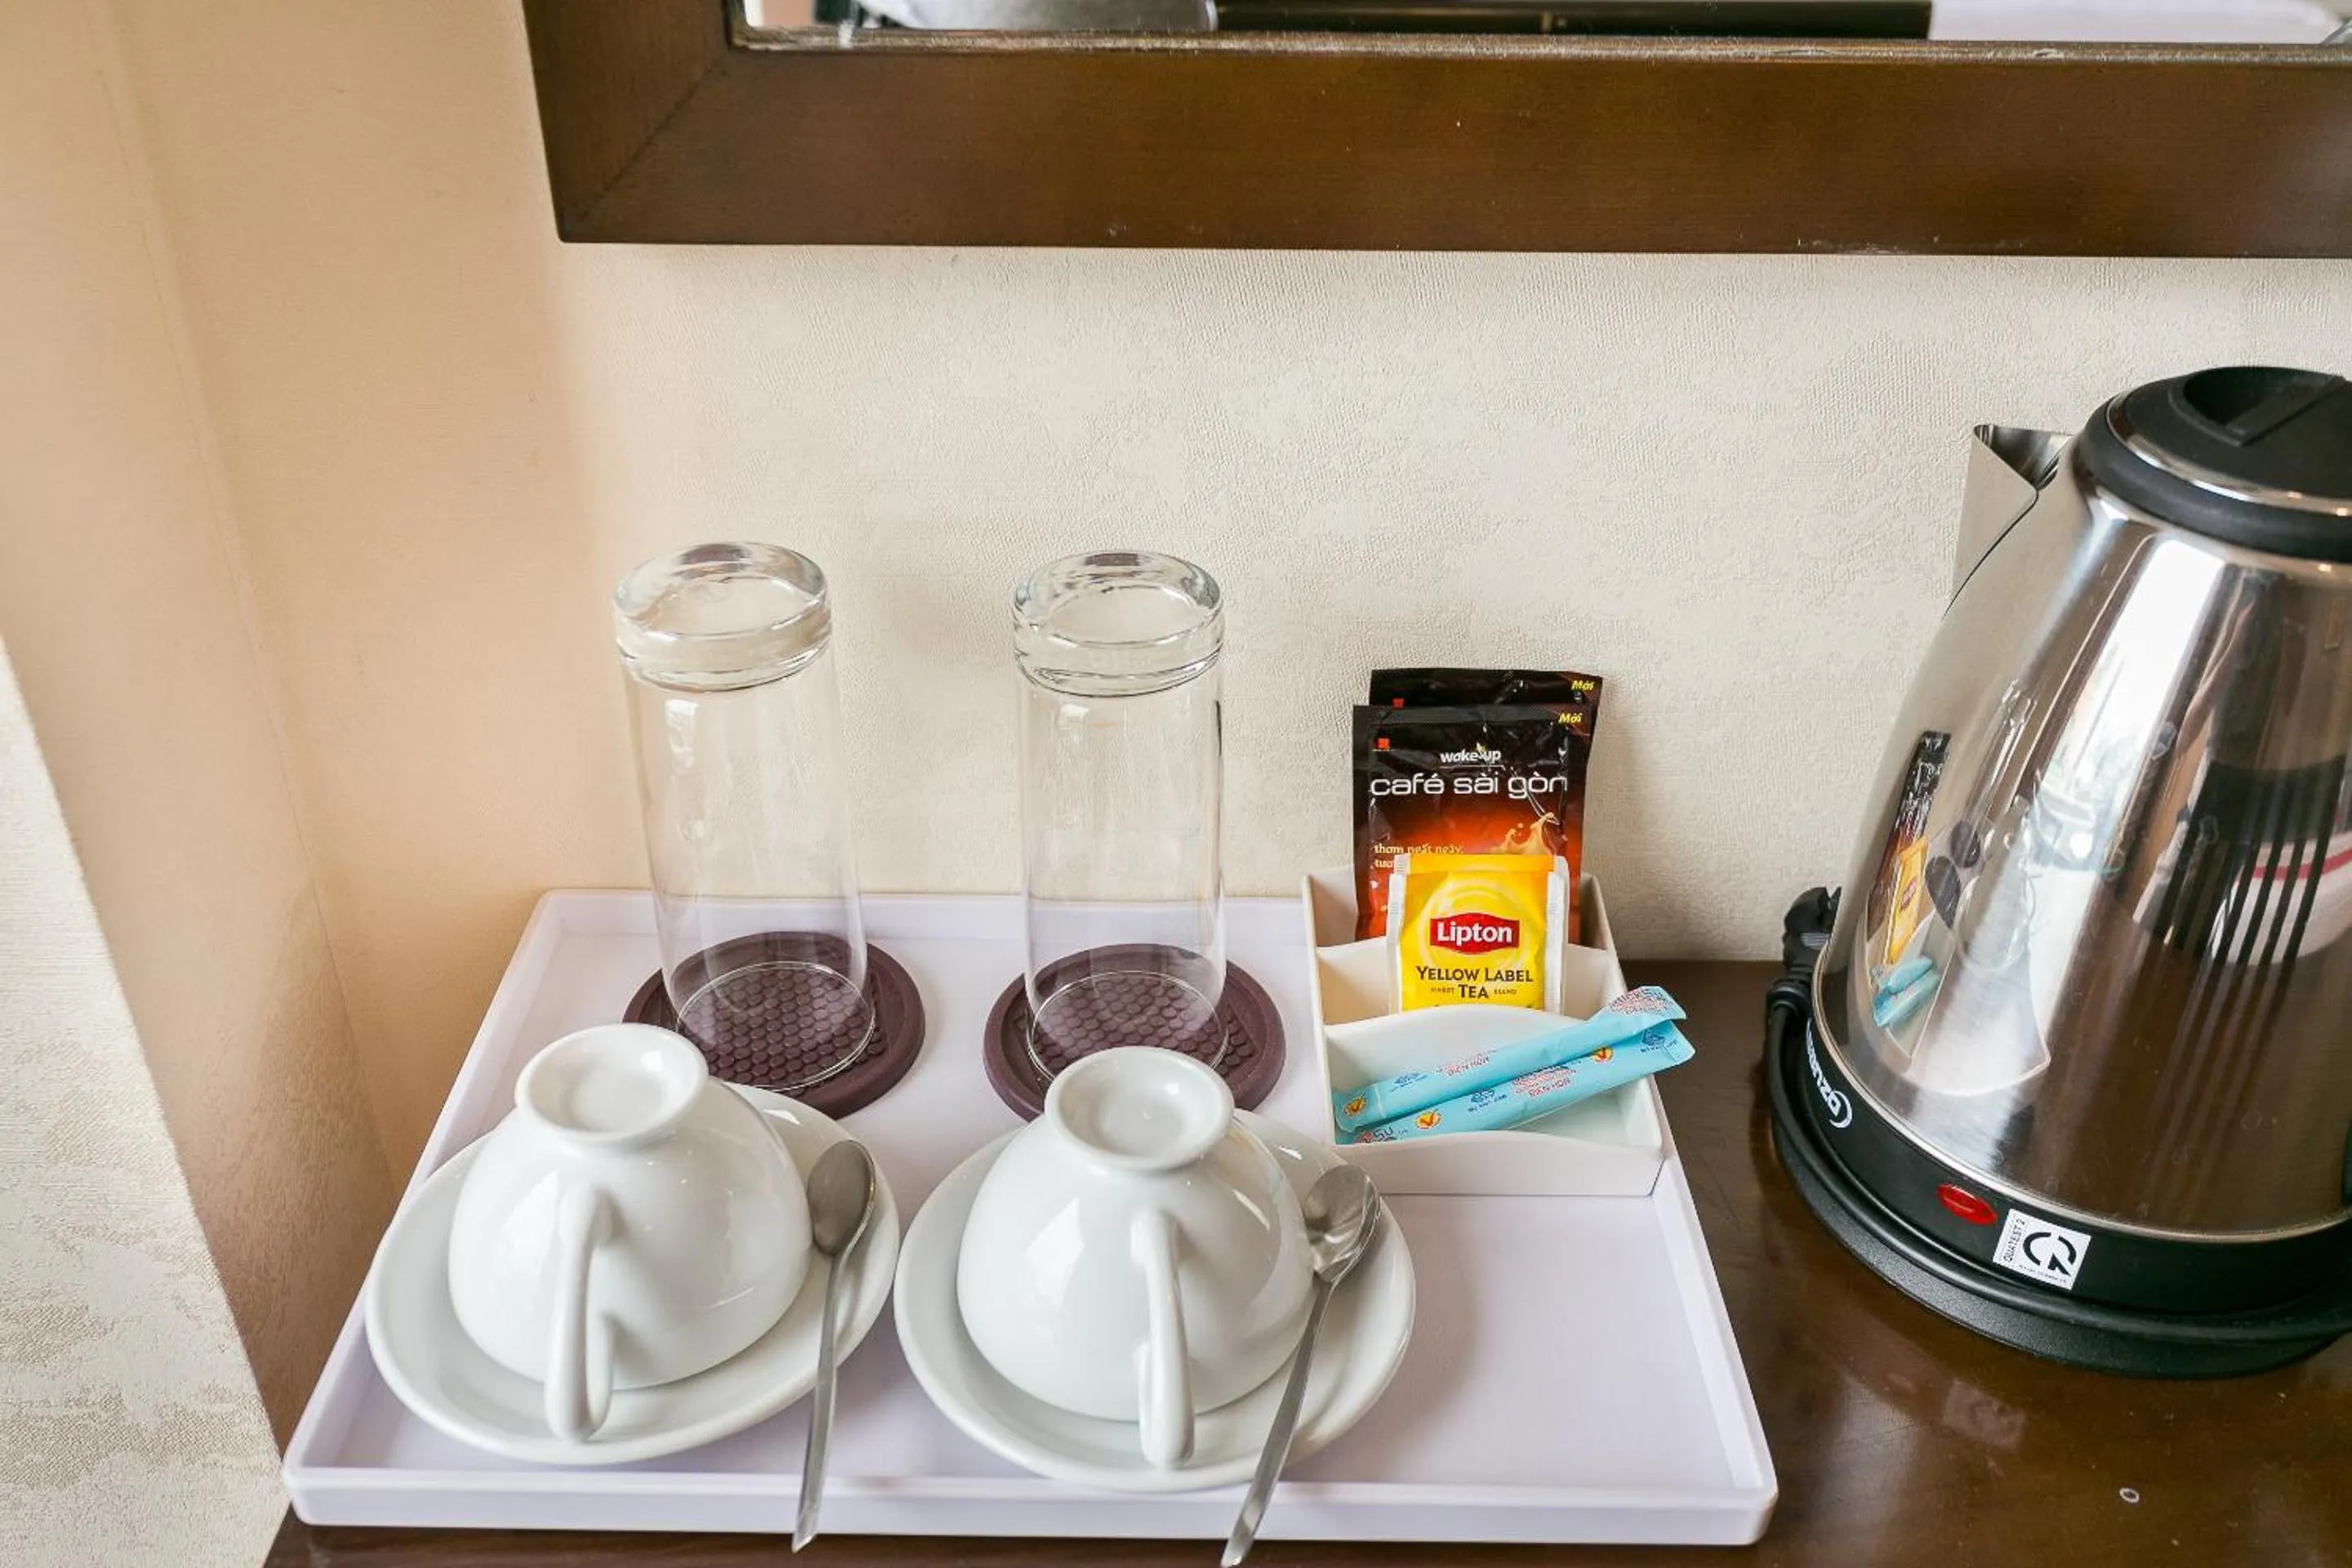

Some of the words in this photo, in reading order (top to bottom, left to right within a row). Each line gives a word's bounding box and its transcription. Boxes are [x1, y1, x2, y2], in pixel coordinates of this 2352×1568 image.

[1370, 773, 1445, 797] café
[1453, 772, 1499, 795] sài
[1508, 771, 1568, 799] gòn
[1437, 920, 1512, 947] Lipton
[1415, 965, 1479, 982] YELLOW
[1485, 968, 1534, 982] LABEL
[1458, 984, 1489, 999] TEA
